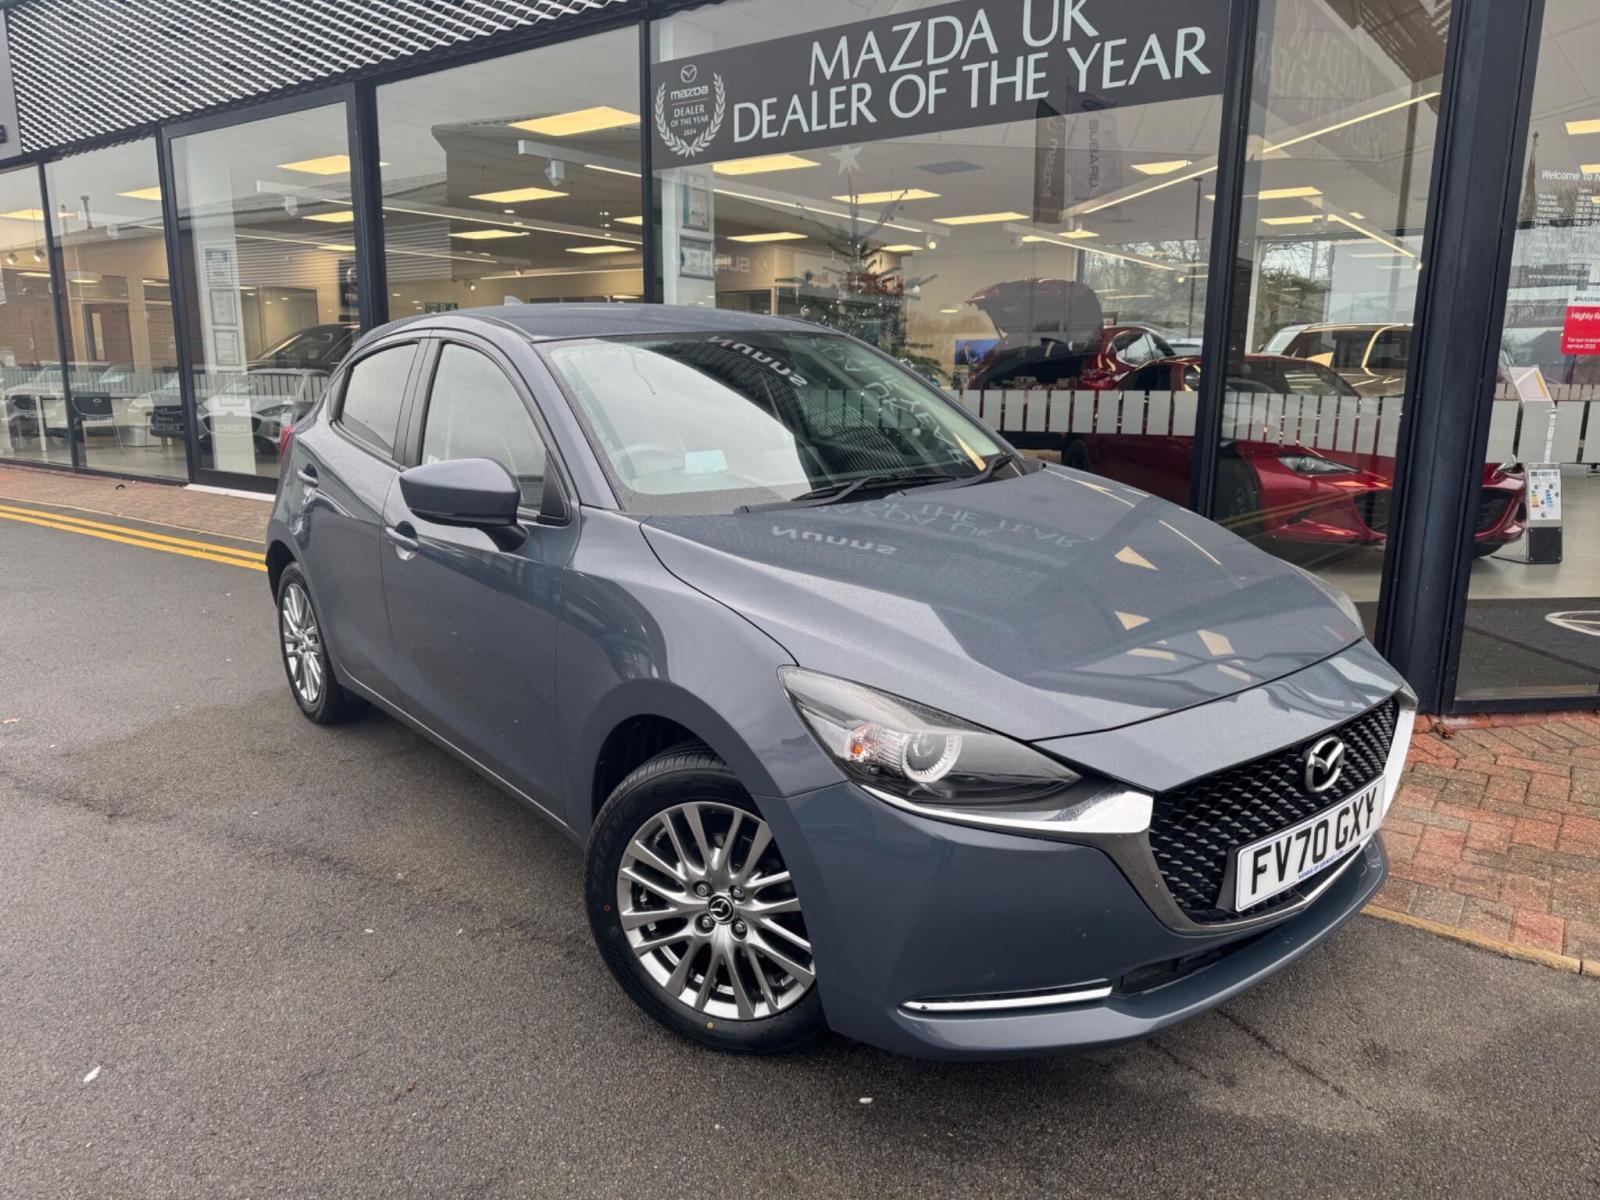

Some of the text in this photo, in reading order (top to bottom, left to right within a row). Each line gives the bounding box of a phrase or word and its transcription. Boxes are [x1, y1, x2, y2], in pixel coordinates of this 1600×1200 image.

[809, 0, 1100, 86] MAZDA UK
[733, 26, 1213, 143] DEALER OF THE YEAR
[670, 85, 708, 101] mazda
[673, 104, 705, 118] DEALER
[670, 114, 709, 128] OF THE YEAR
[1088, 119, 1099, 188] SUBARU
[1541, 169, 1581, 181] Welcome
[1571, 311, 1593, 321] Highly
[1252, 819, 1329, 895] FV70
[1335, 787, 1378, 850] GXY
